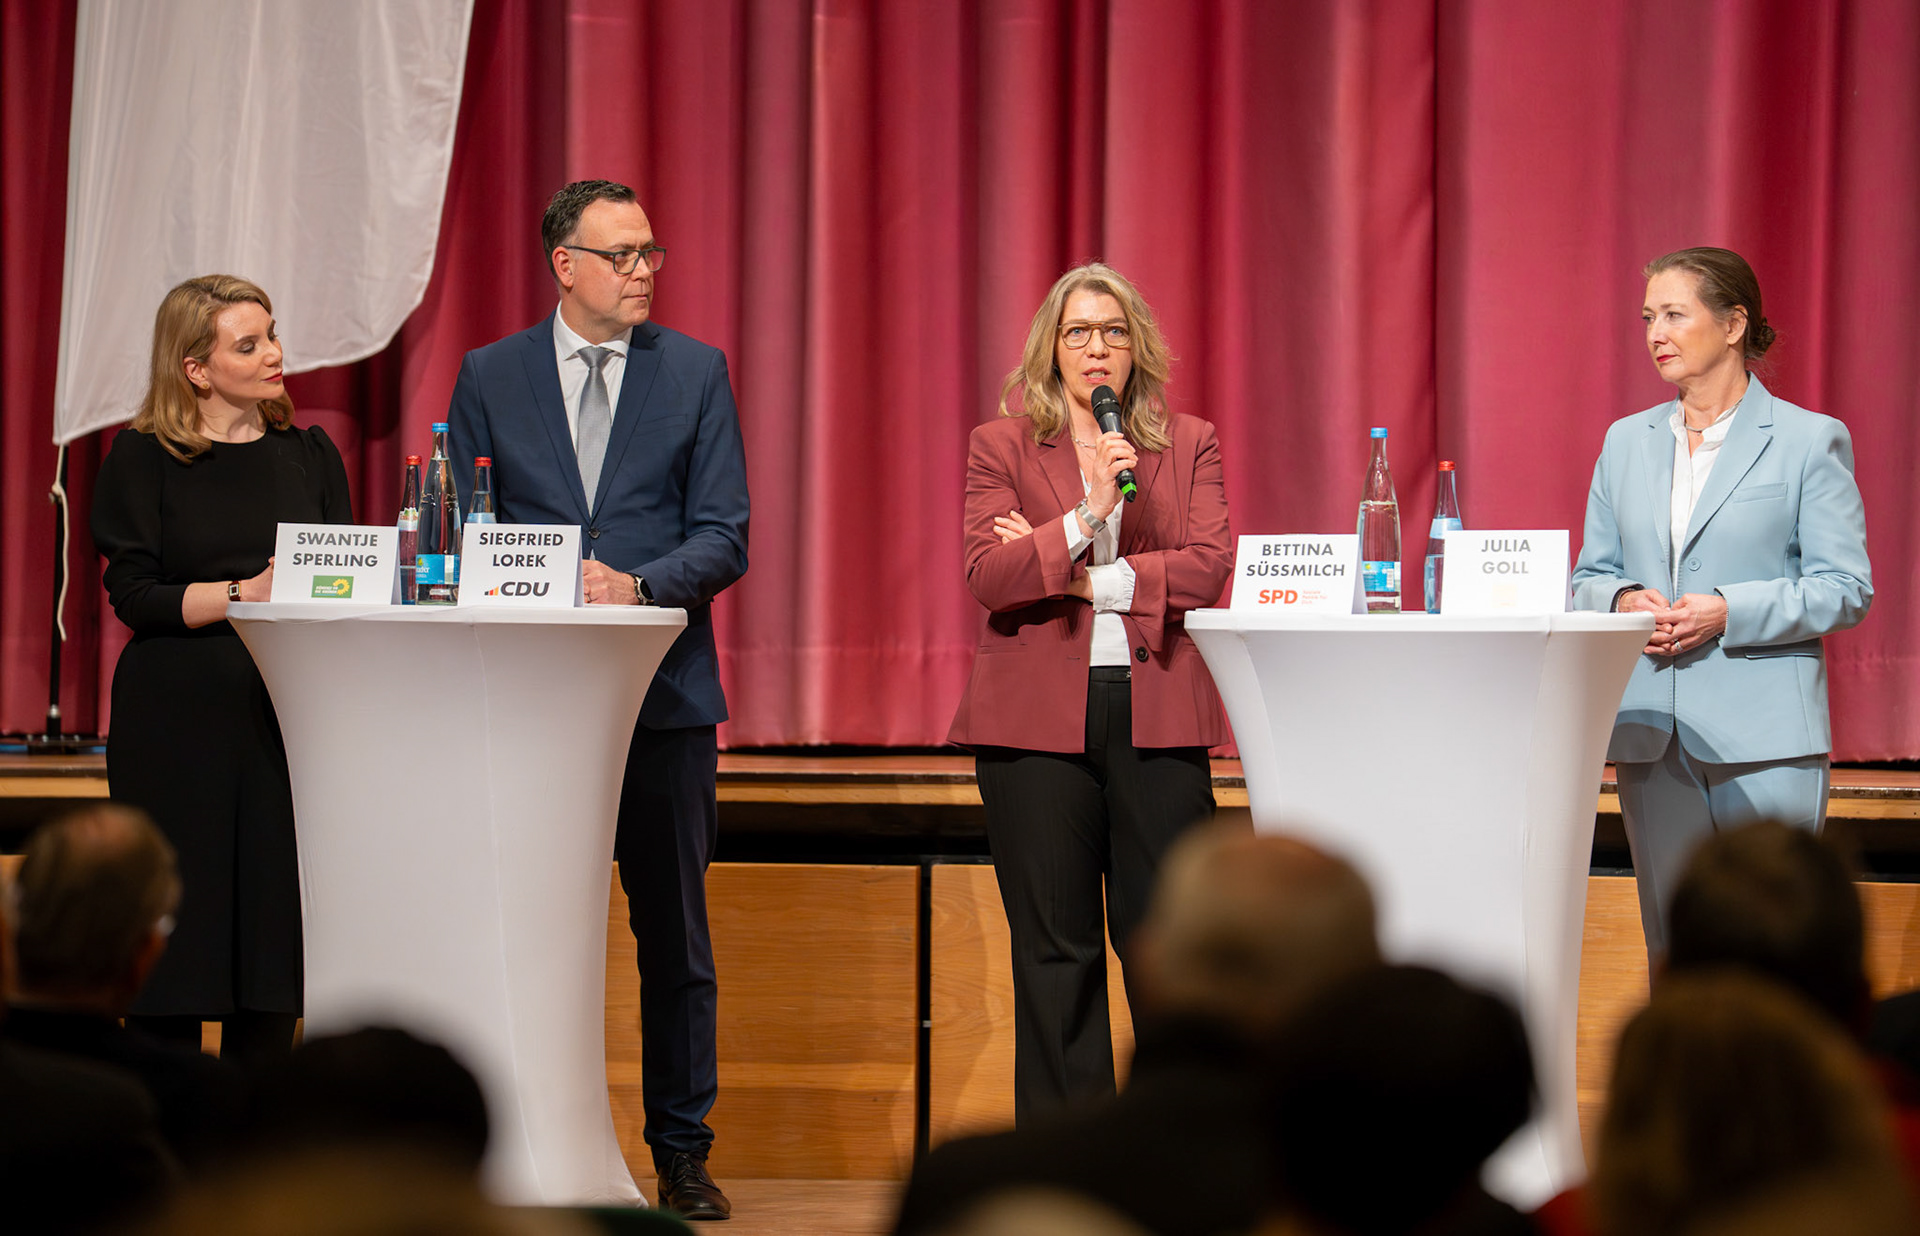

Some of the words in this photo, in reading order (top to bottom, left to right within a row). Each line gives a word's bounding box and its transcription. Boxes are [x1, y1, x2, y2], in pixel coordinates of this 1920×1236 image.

[297, 532, 378, 547] SWANTJE
[479, 532, 564, 546] SIEGFRIED
[1481, 539, 1531, 553] JULIA
[1262, 544, 1333, 556] BETTINA
[292, 553, 378, 567] SPERLING
[492, 554, 546, 567] LOREK
[1246, 561, 1345, 576] SÜSSMILCH
[1482, 561, 1529, 574] GOLL
[500, 581, 550, 597] CDU
[1258, 589, 1298, 604] SPD
